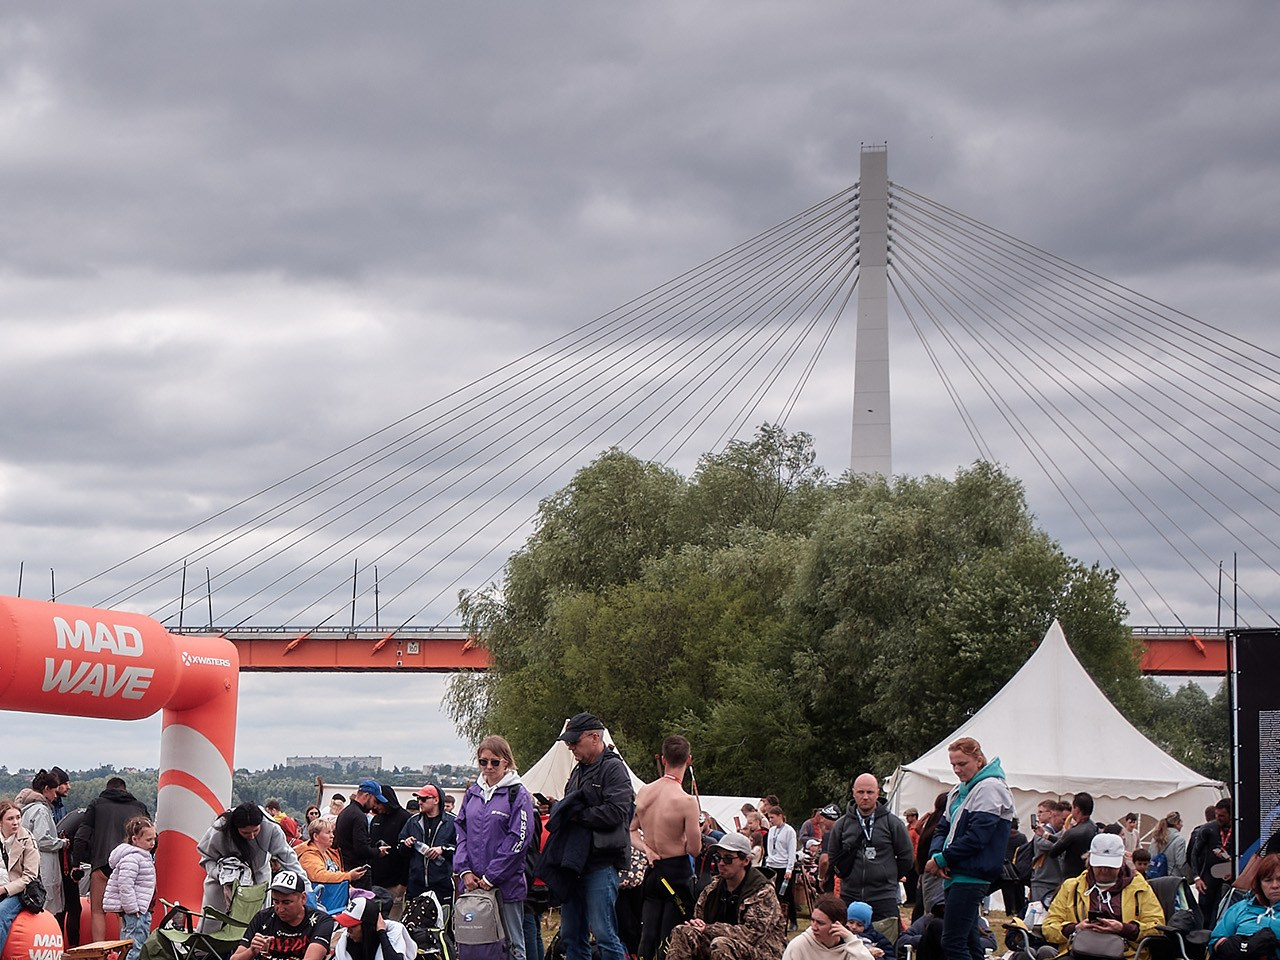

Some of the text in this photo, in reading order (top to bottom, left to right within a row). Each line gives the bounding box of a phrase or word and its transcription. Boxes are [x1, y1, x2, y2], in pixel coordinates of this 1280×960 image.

[53, 616, 144, 658] MAD
[42, 657, 155, 700] WAVE
[33, 933, 63, 948] MAD
